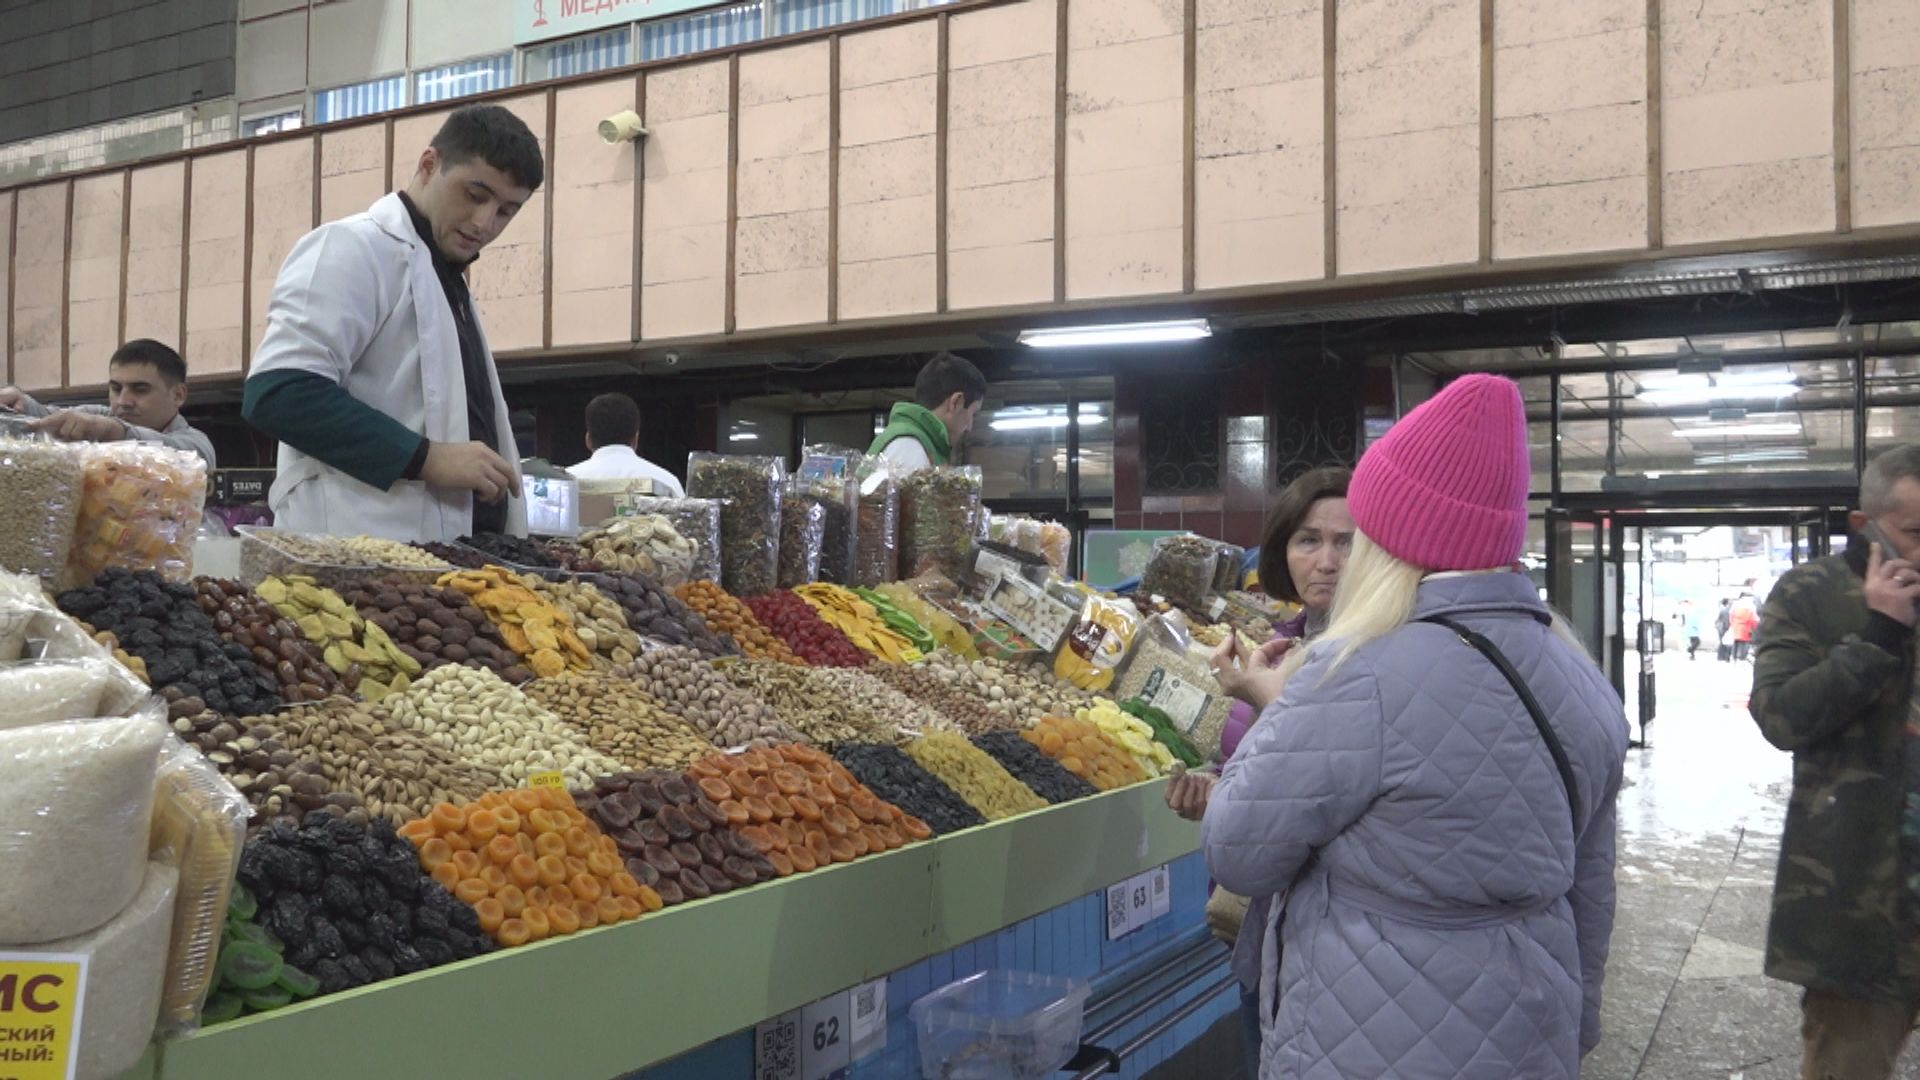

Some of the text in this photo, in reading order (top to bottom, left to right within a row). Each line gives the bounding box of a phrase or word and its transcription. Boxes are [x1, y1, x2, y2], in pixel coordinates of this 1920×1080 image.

[232, 482, 262, 491] DATES
[1134, 886, 1146, 909] 63
[813, 1016, 840, 1051] 62
